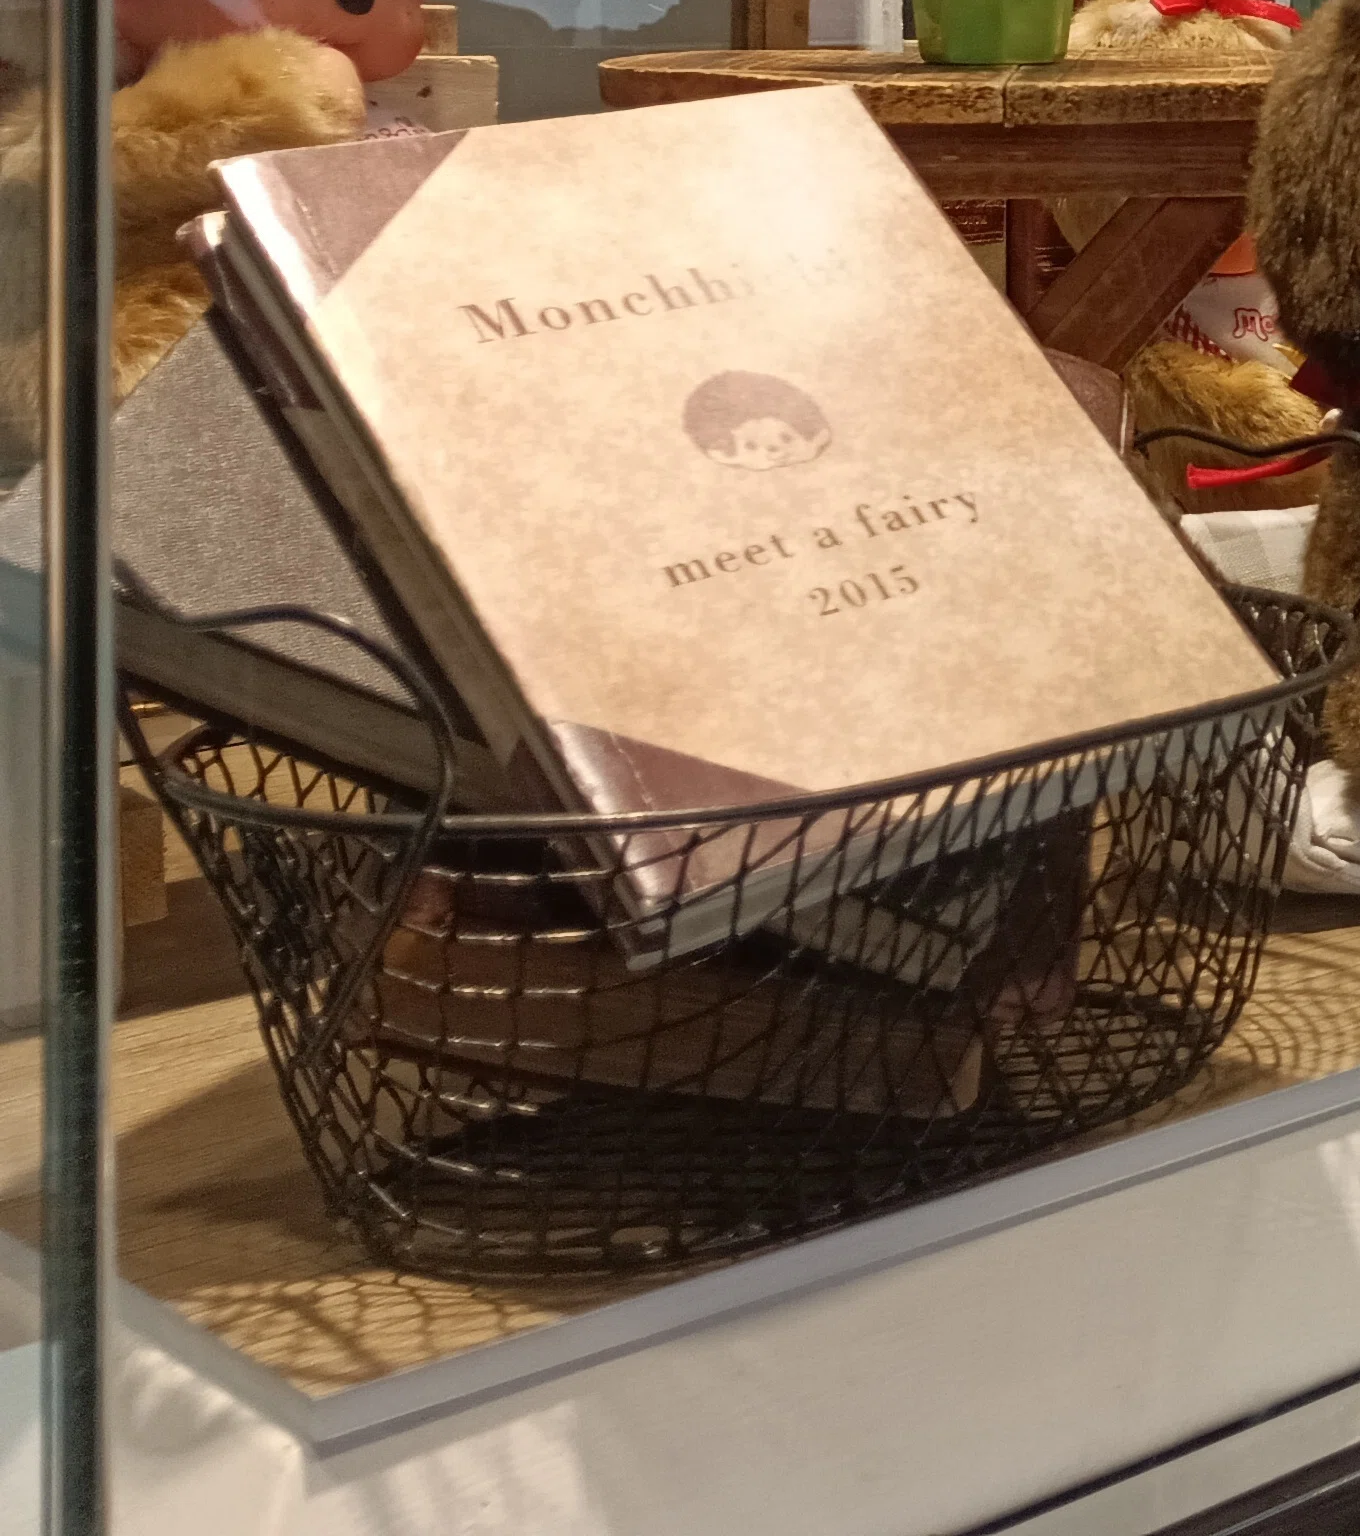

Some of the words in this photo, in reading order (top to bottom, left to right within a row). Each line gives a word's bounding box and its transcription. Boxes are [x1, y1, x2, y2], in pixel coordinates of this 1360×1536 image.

[662, 533, 795, 588] meet
[812, 526, 843, 550] a
[854, 490, 980, 538] fairy
[808, 564, 920, 616] 2015
